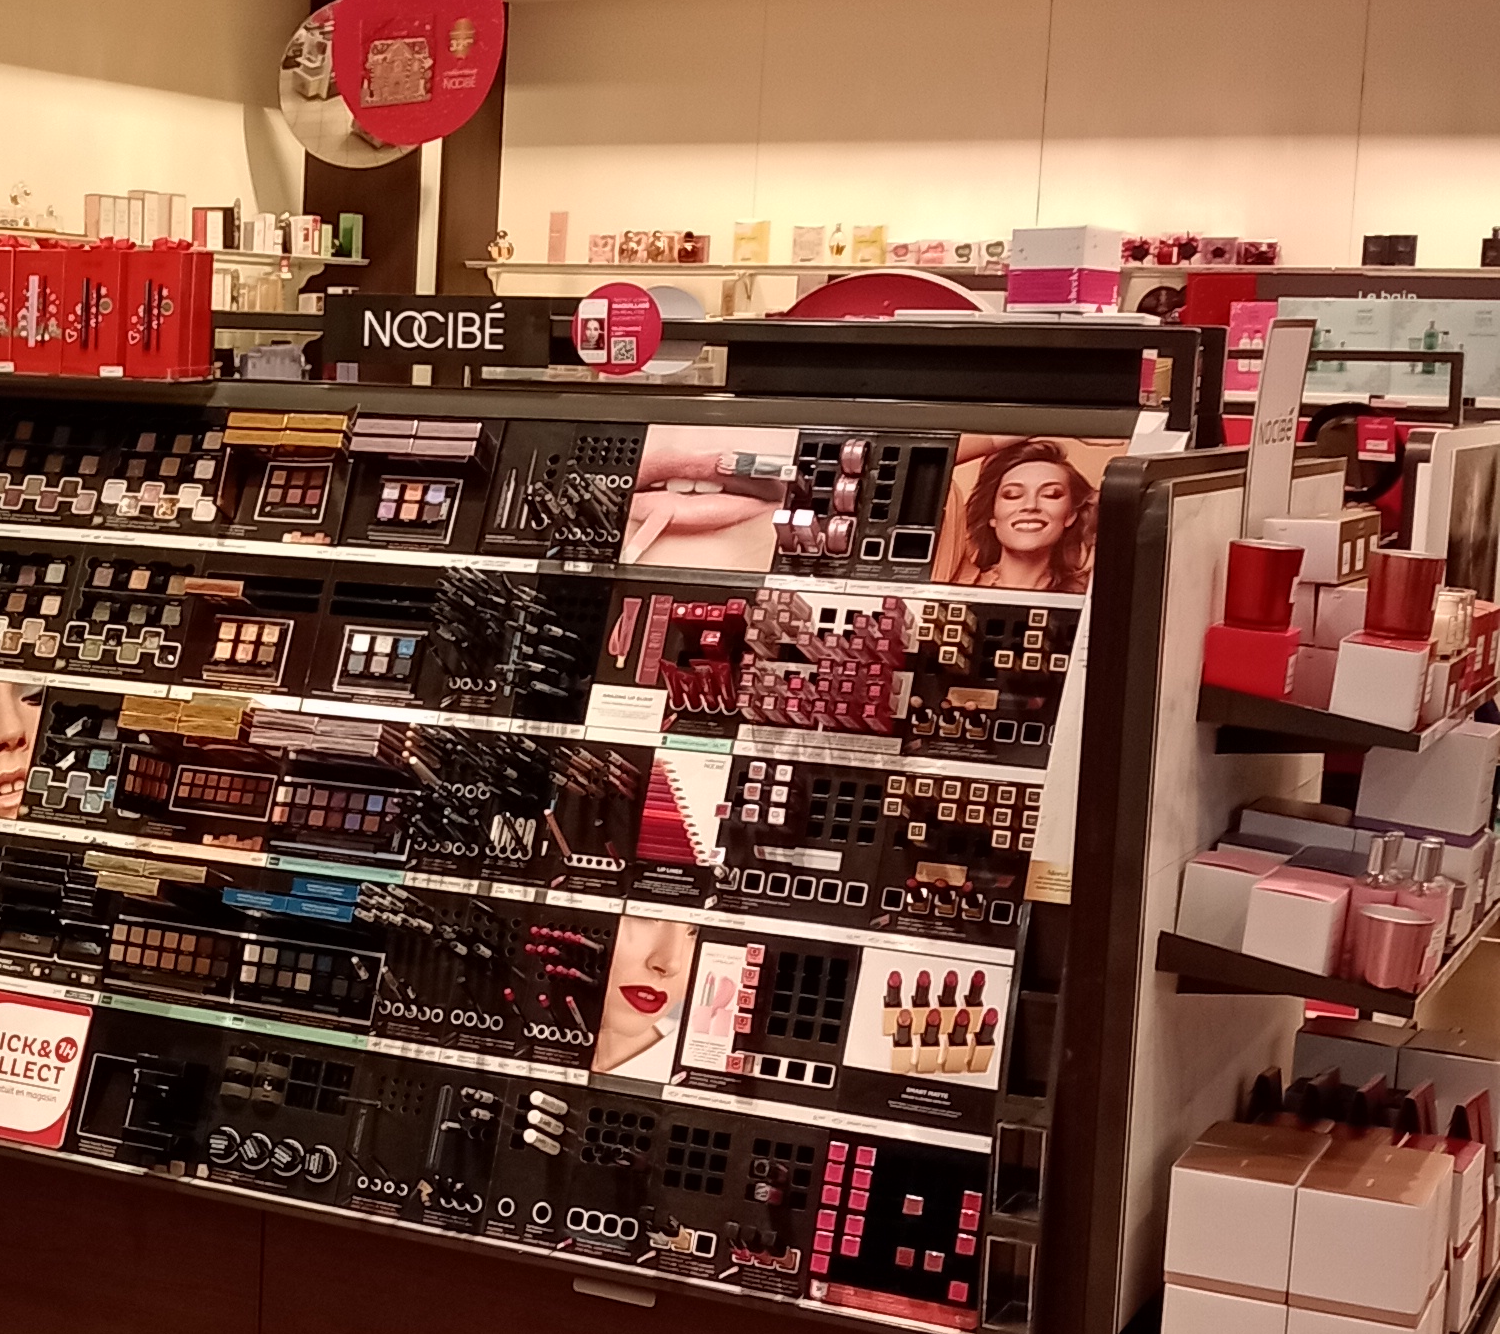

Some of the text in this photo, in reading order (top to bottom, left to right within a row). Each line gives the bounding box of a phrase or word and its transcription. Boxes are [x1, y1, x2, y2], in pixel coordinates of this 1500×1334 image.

[363, 302, 506, 350] NOCIBÉ
[1257, 406, 1295, 445] NOCIBÉ
[58, 1041, 77, 1060] 1H
[15, 1088, 25, 1097] en
[25, 1090, 57, 1103] magasin
